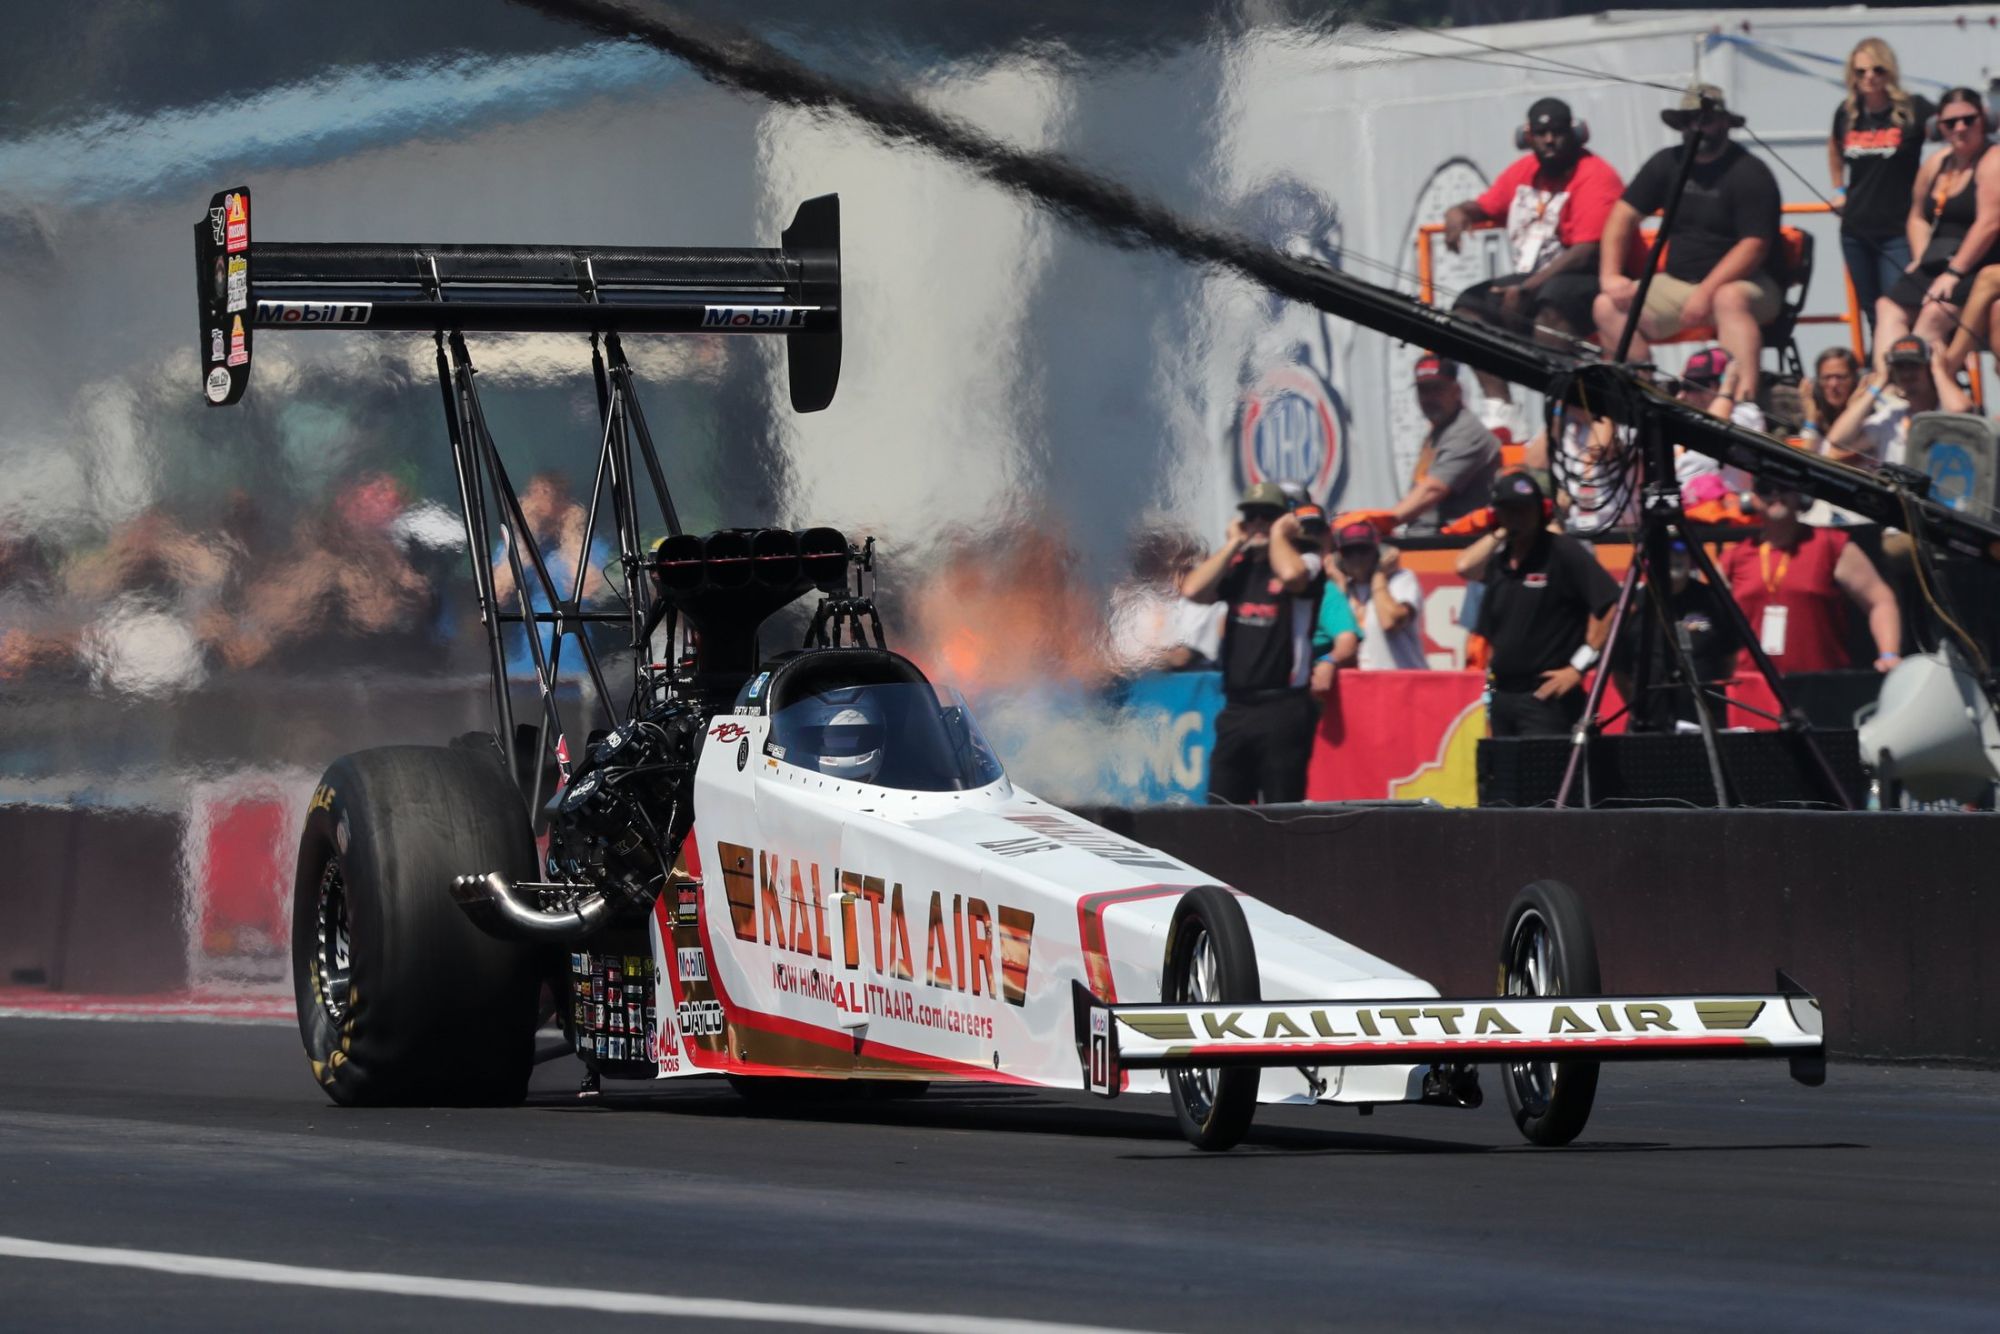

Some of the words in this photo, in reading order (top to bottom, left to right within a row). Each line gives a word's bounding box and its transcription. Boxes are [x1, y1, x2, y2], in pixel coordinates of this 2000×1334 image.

[259, 303, 337, 322] Mobil
[706, 308, 786, 326] Mobil
[760, 849, 915, 982] KALTTA
[926, 890, 997, 1000] AIR
[679, 952, 699, 977] Mobil
[772, 961, 798, 994] NOW
[835, 981, 993, 1040] ALITTAAIR.com/careers
[677, 1001, 724, 1036] DAYCO
[1202, 1007, 1522, 1039] KALITTA
[1549, 1003, 1679, 1033] AIR
[659, 1017, 679, 1057] MAC
[660, 1058, 680, 1073] TOOLS
